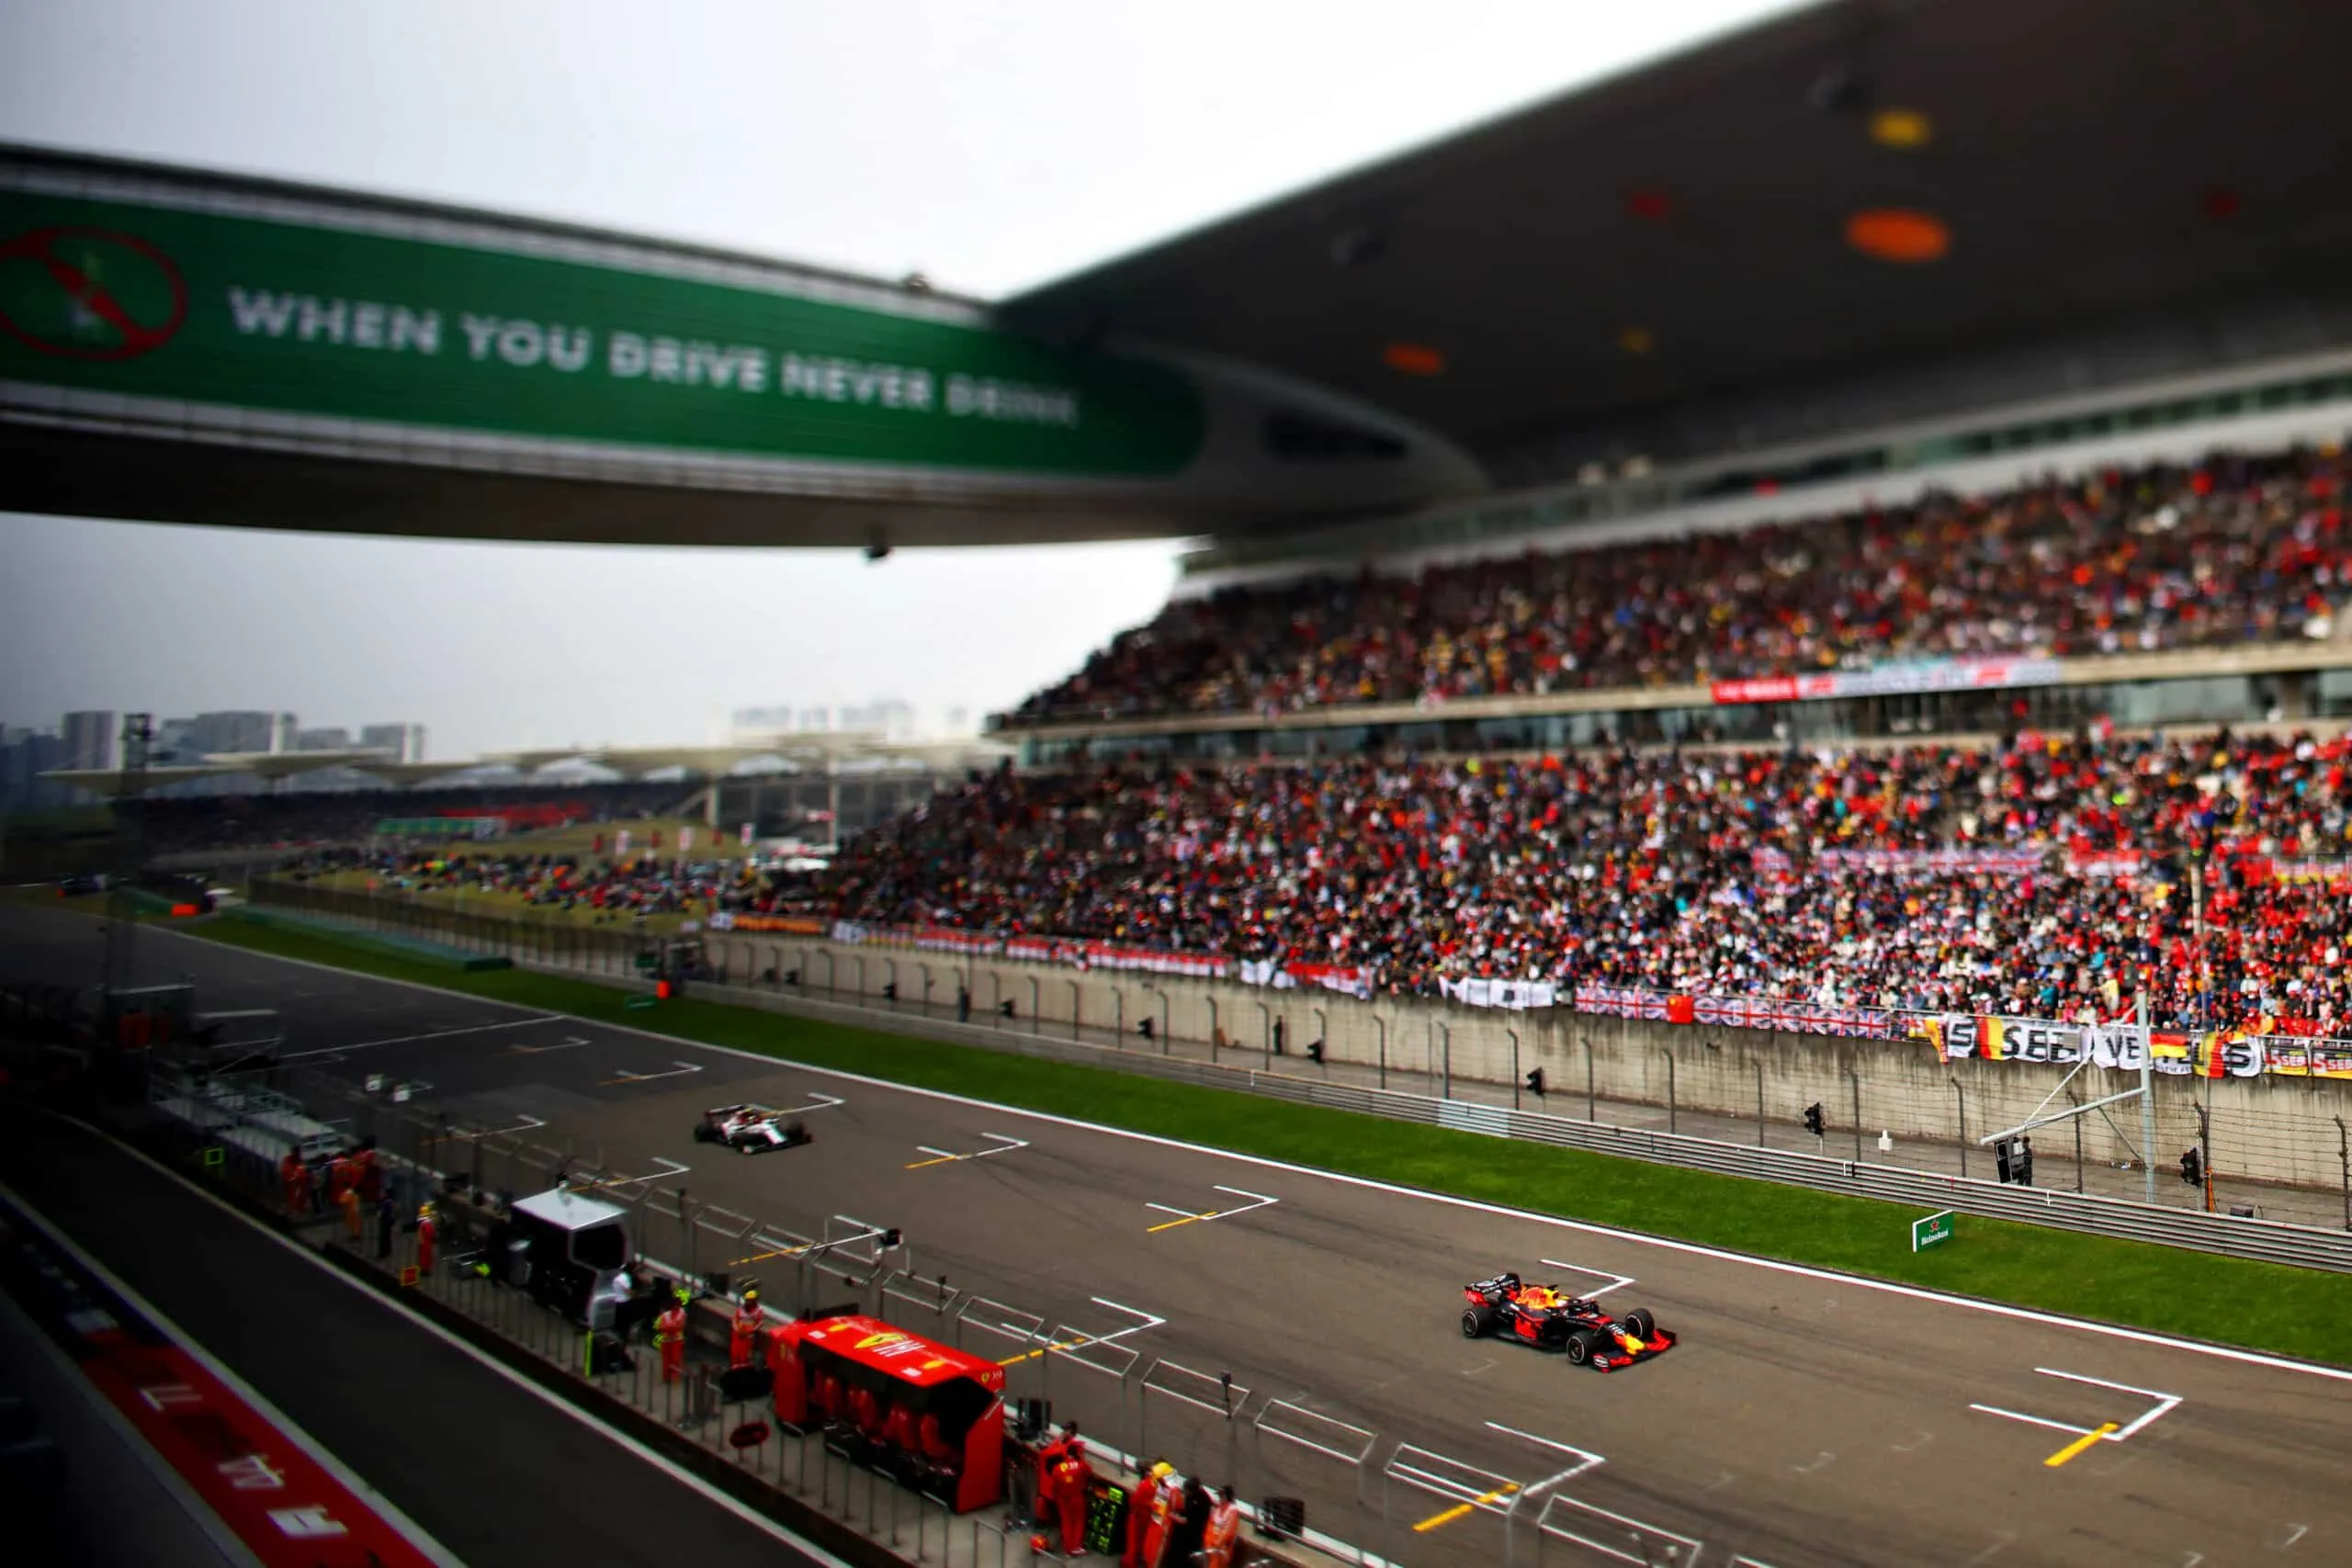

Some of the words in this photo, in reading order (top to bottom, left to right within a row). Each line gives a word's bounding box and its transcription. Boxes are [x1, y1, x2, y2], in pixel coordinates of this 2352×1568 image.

[229, 286, 439, 355] WHEN
[460, 313, 593, 372] YOU
[607, 329, 769, 393] DRIVE
[783, 354, 933, 412] NEVER
